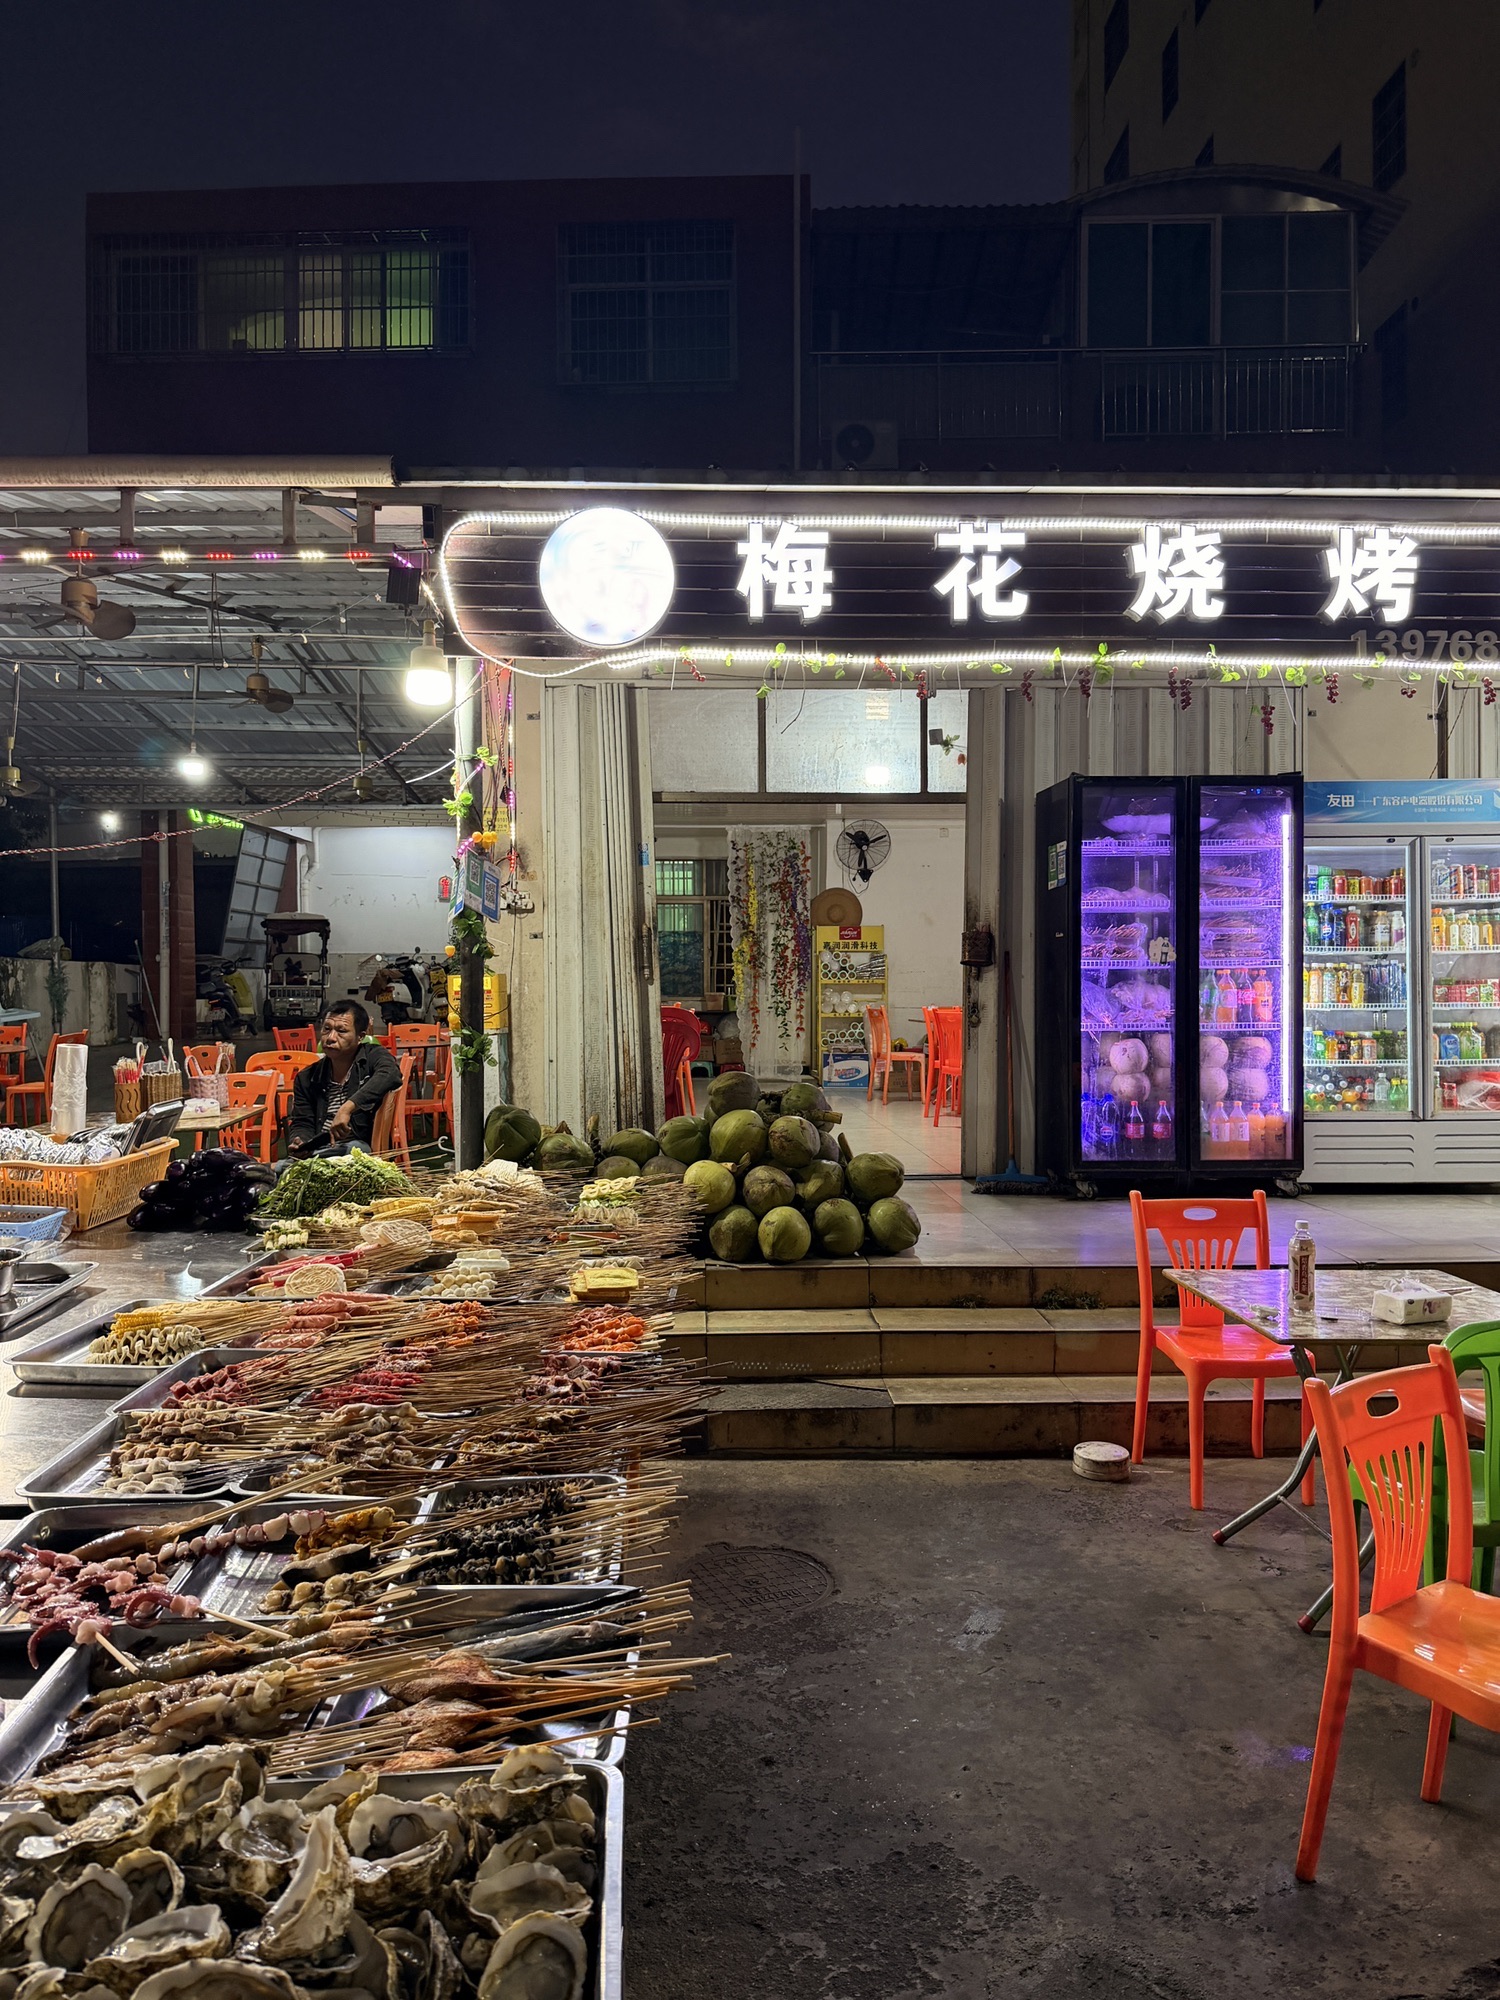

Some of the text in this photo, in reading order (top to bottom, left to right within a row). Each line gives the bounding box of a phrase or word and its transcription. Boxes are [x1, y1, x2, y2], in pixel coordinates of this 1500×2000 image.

[736, 519, 1420, 625] 梅花烧烤
[1351, 629, 1499, 663] 139768
[1327, 794, 1355, 808] 友田
